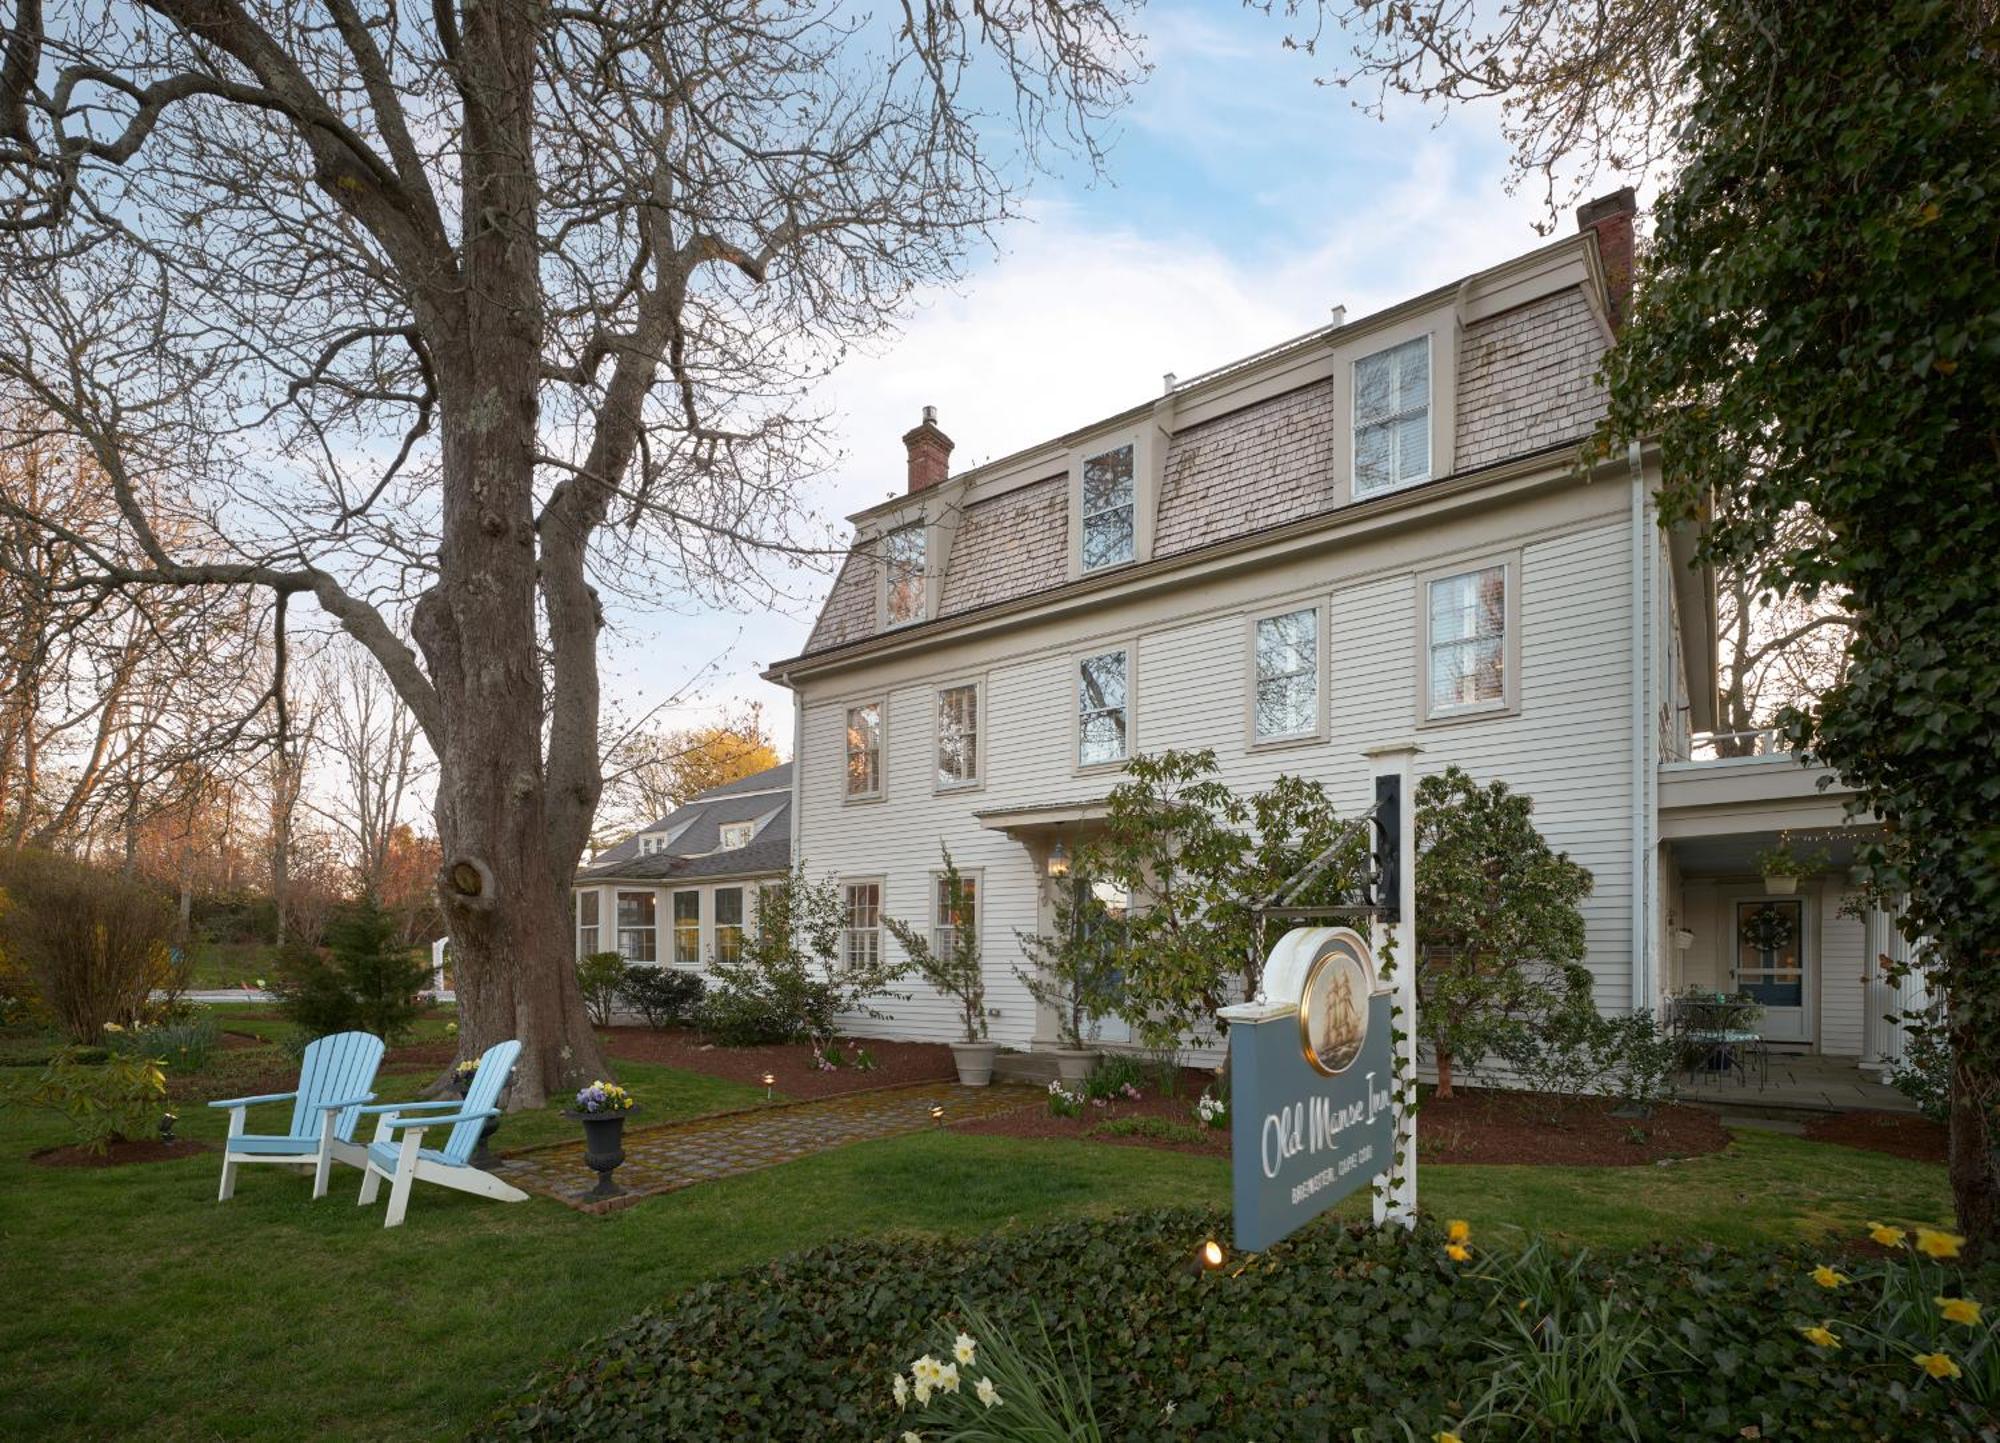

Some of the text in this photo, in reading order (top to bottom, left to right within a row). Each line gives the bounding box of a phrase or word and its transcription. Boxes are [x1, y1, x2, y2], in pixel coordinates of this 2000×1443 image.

[1262, 1071, 1390, 1178] Old Manse Inn
